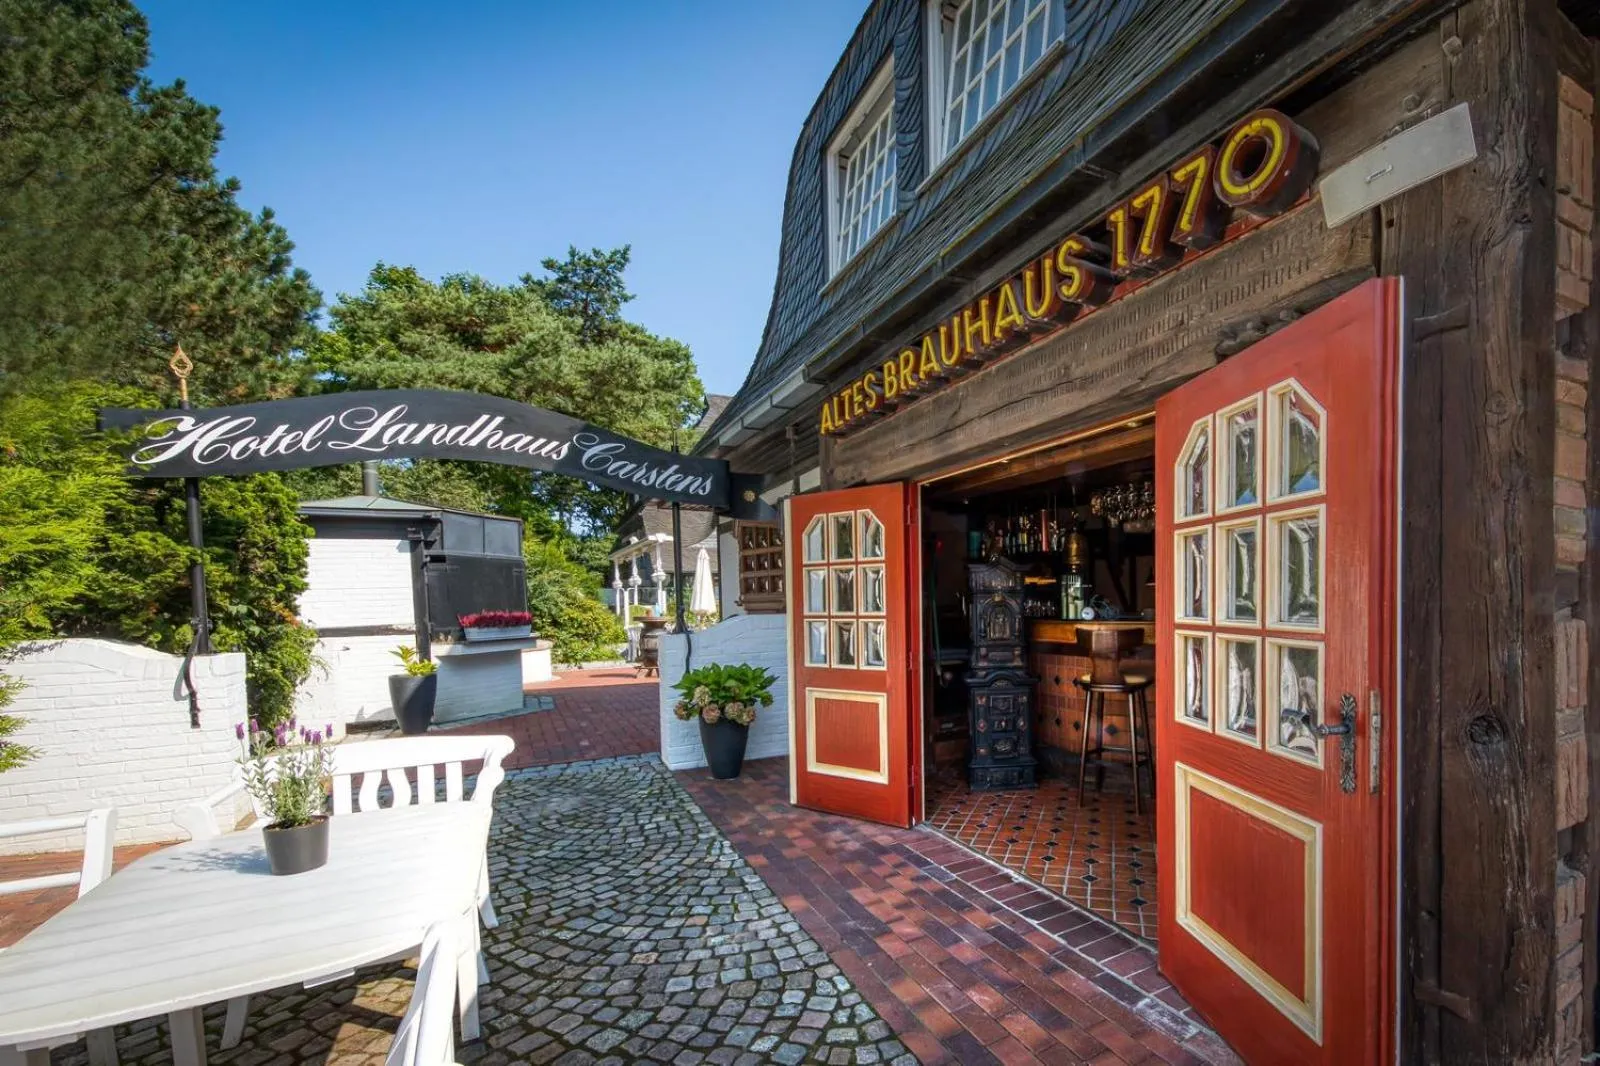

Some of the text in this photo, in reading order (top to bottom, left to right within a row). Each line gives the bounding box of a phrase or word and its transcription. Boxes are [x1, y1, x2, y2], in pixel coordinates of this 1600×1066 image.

[820, 371, 878, 435] ALTES
[882, 236, 1084, 399] BRAUHAUS
[1108, 113, 1288, 268] 1770
[130, 403, 715, 497] Hotel Landhaus Carstens
